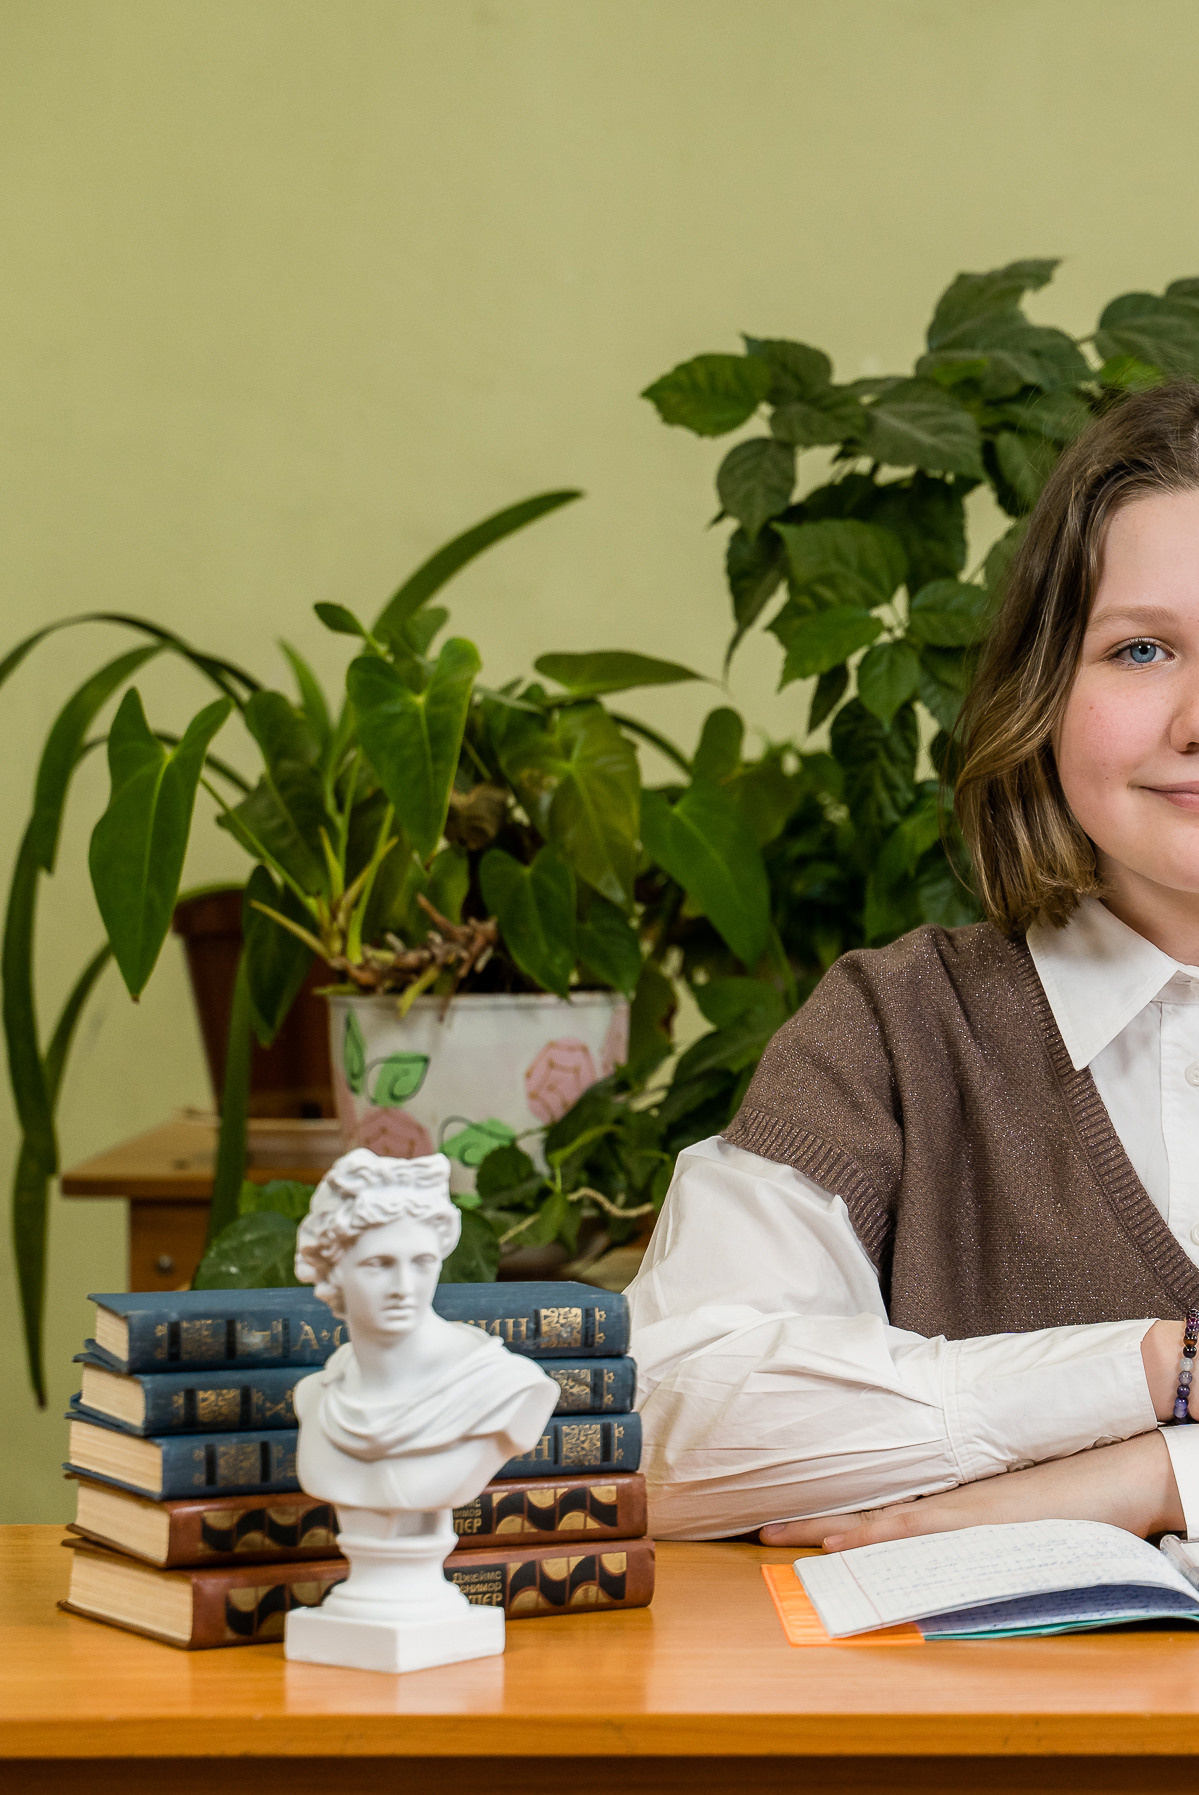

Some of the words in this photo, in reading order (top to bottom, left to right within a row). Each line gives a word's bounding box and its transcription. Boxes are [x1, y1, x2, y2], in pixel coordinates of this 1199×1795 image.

[453, 1517, 482, 1534] ПЕР
[459, 1581, 503, 1594] енимор
[468, 1592, 504, 1606] ПЕР
